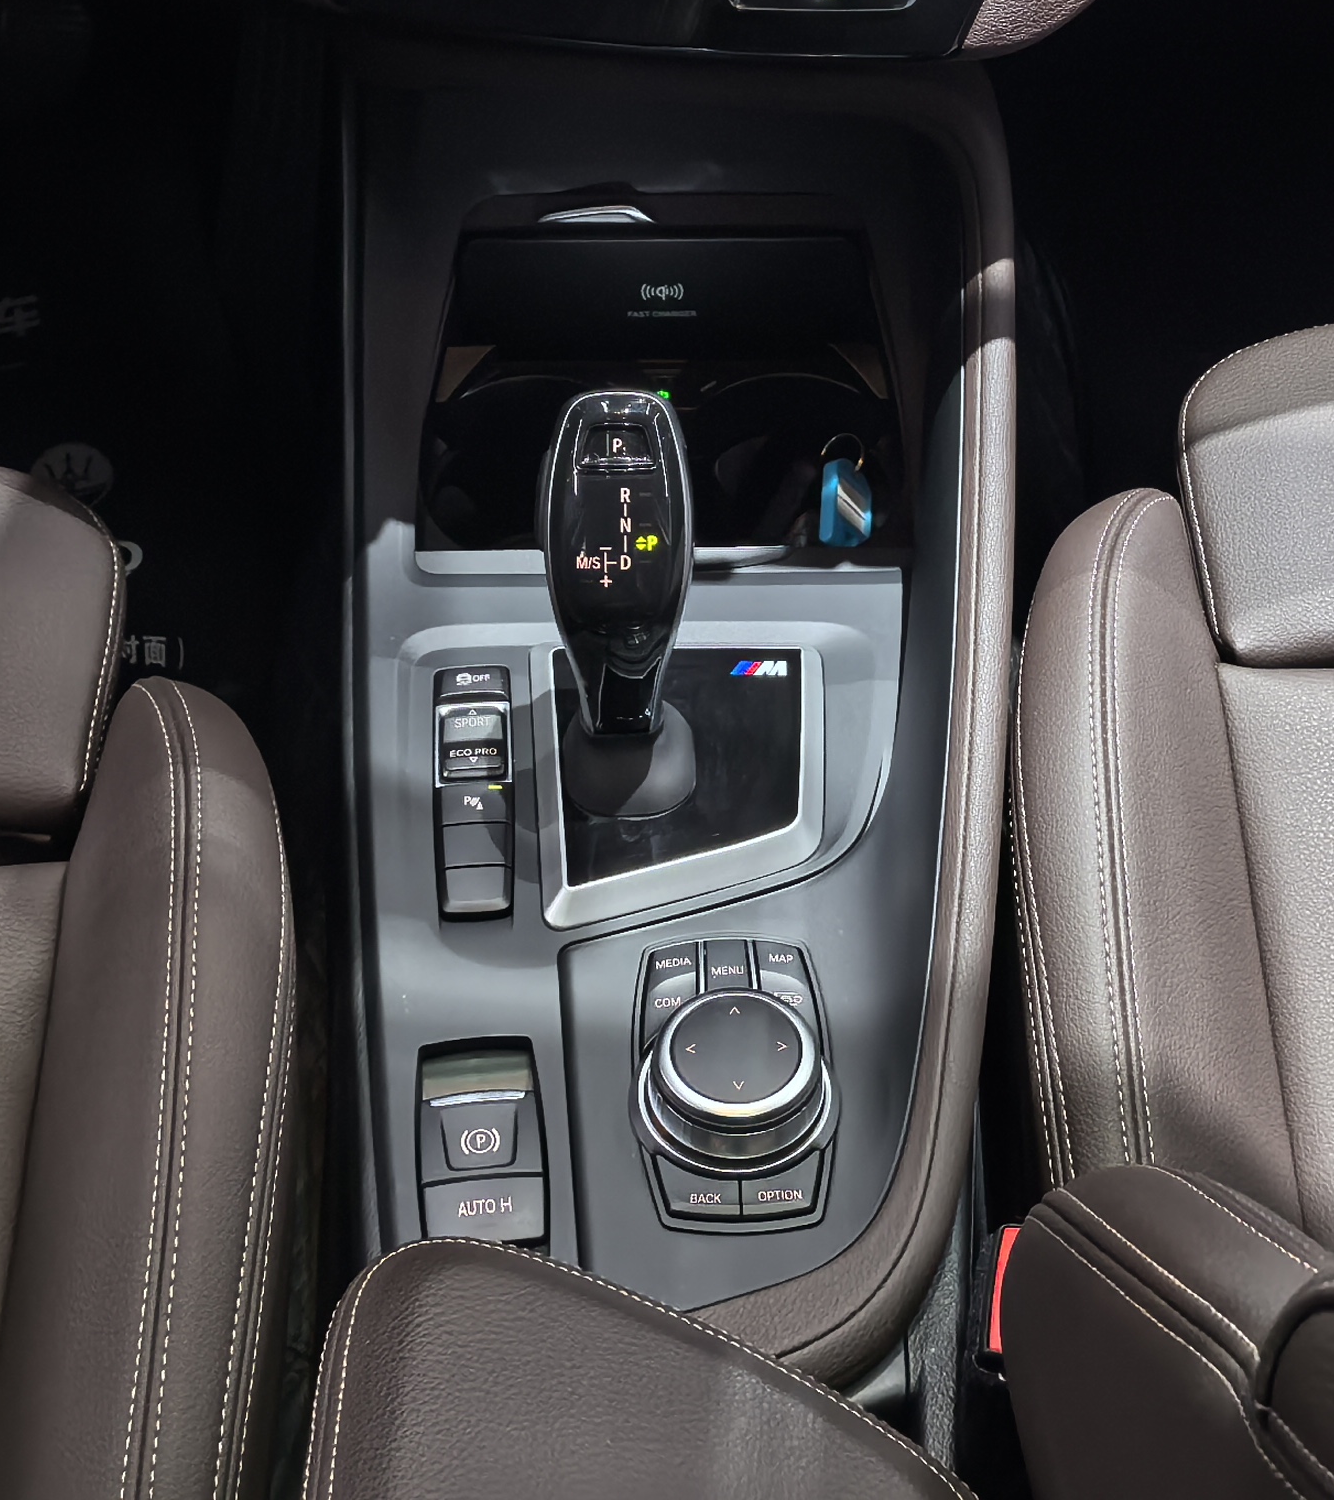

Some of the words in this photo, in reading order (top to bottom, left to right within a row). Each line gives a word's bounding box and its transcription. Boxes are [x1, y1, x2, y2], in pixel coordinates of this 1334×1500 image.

[612, 438, 623, 453] P
[620, 487, 631, 503] R
[620, 517, 632, 533] N
[647, 535, 658, 551] P
[576, 556, 601, 569] M/S
[620, 555, 632, 570] D
[472, 674, 491, 683] OFF
[454, 716, 491, 729] SPORT
[449, 749, 473, 758] ECO
[474, 747, 498, 756] PRO
[655, 957, 692, 970] MEDIA
[768, 953, 794, 963] MAP
[711, 965, 744, 976] MENU
[654, 997, 682, 1009] COM
[475, 1133, 486, 1149] P
[689, 1192, 722, 1205] BACK
[757, 1188, 803, 1202] OPTION
[457, 1202, 496, 1218] AUTO
[500, 1198, 513, 1213] H
